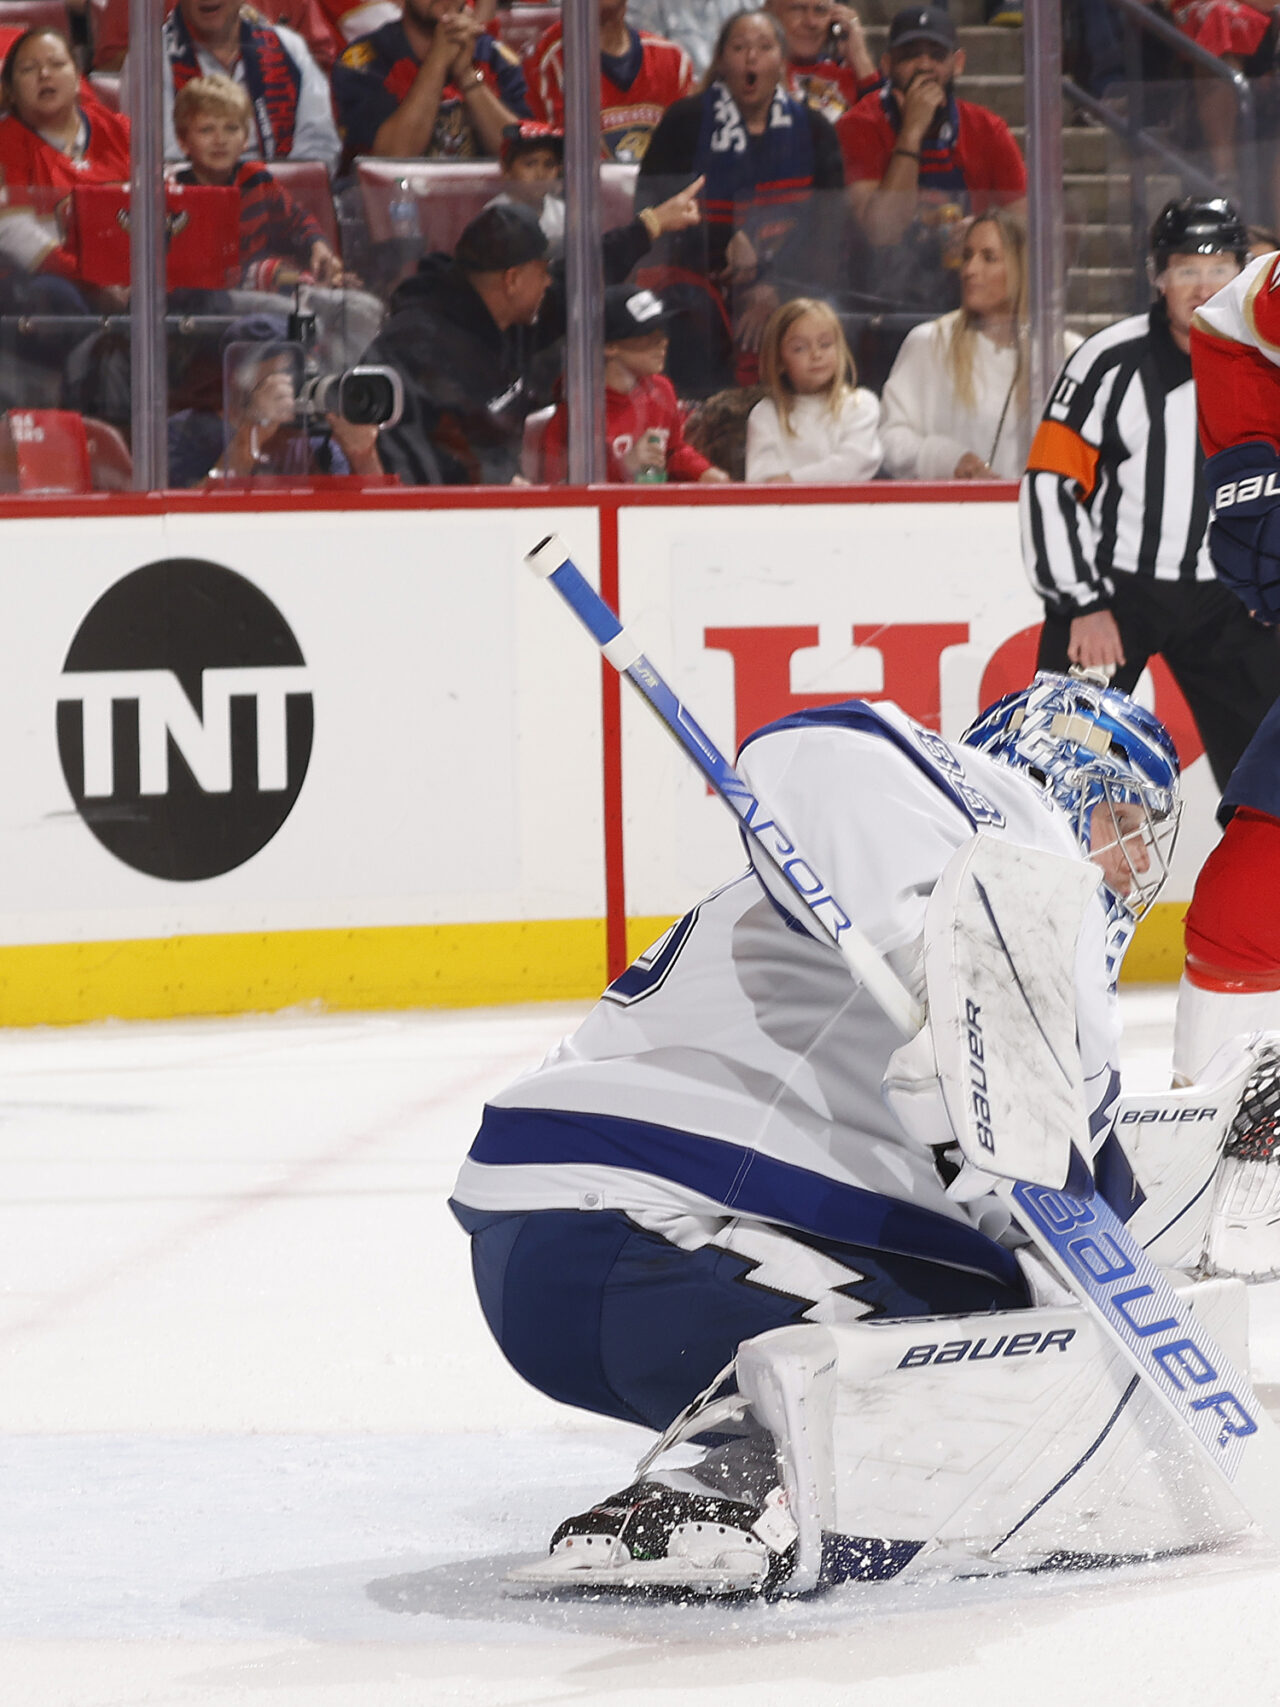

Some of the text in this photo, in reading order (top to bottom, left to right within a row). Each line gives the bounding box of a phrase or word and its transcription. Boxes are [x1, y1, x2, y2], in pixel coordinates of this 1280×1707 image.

[56, 665, 314, 798] TNT
[966, 997, 996, 1156] BAUER
[1119, 1107, 1219, 1125] BAUER
[896, 1328, 1077, 1371] BAUER
[1020, 1184, 1259, 1450] BAUER
